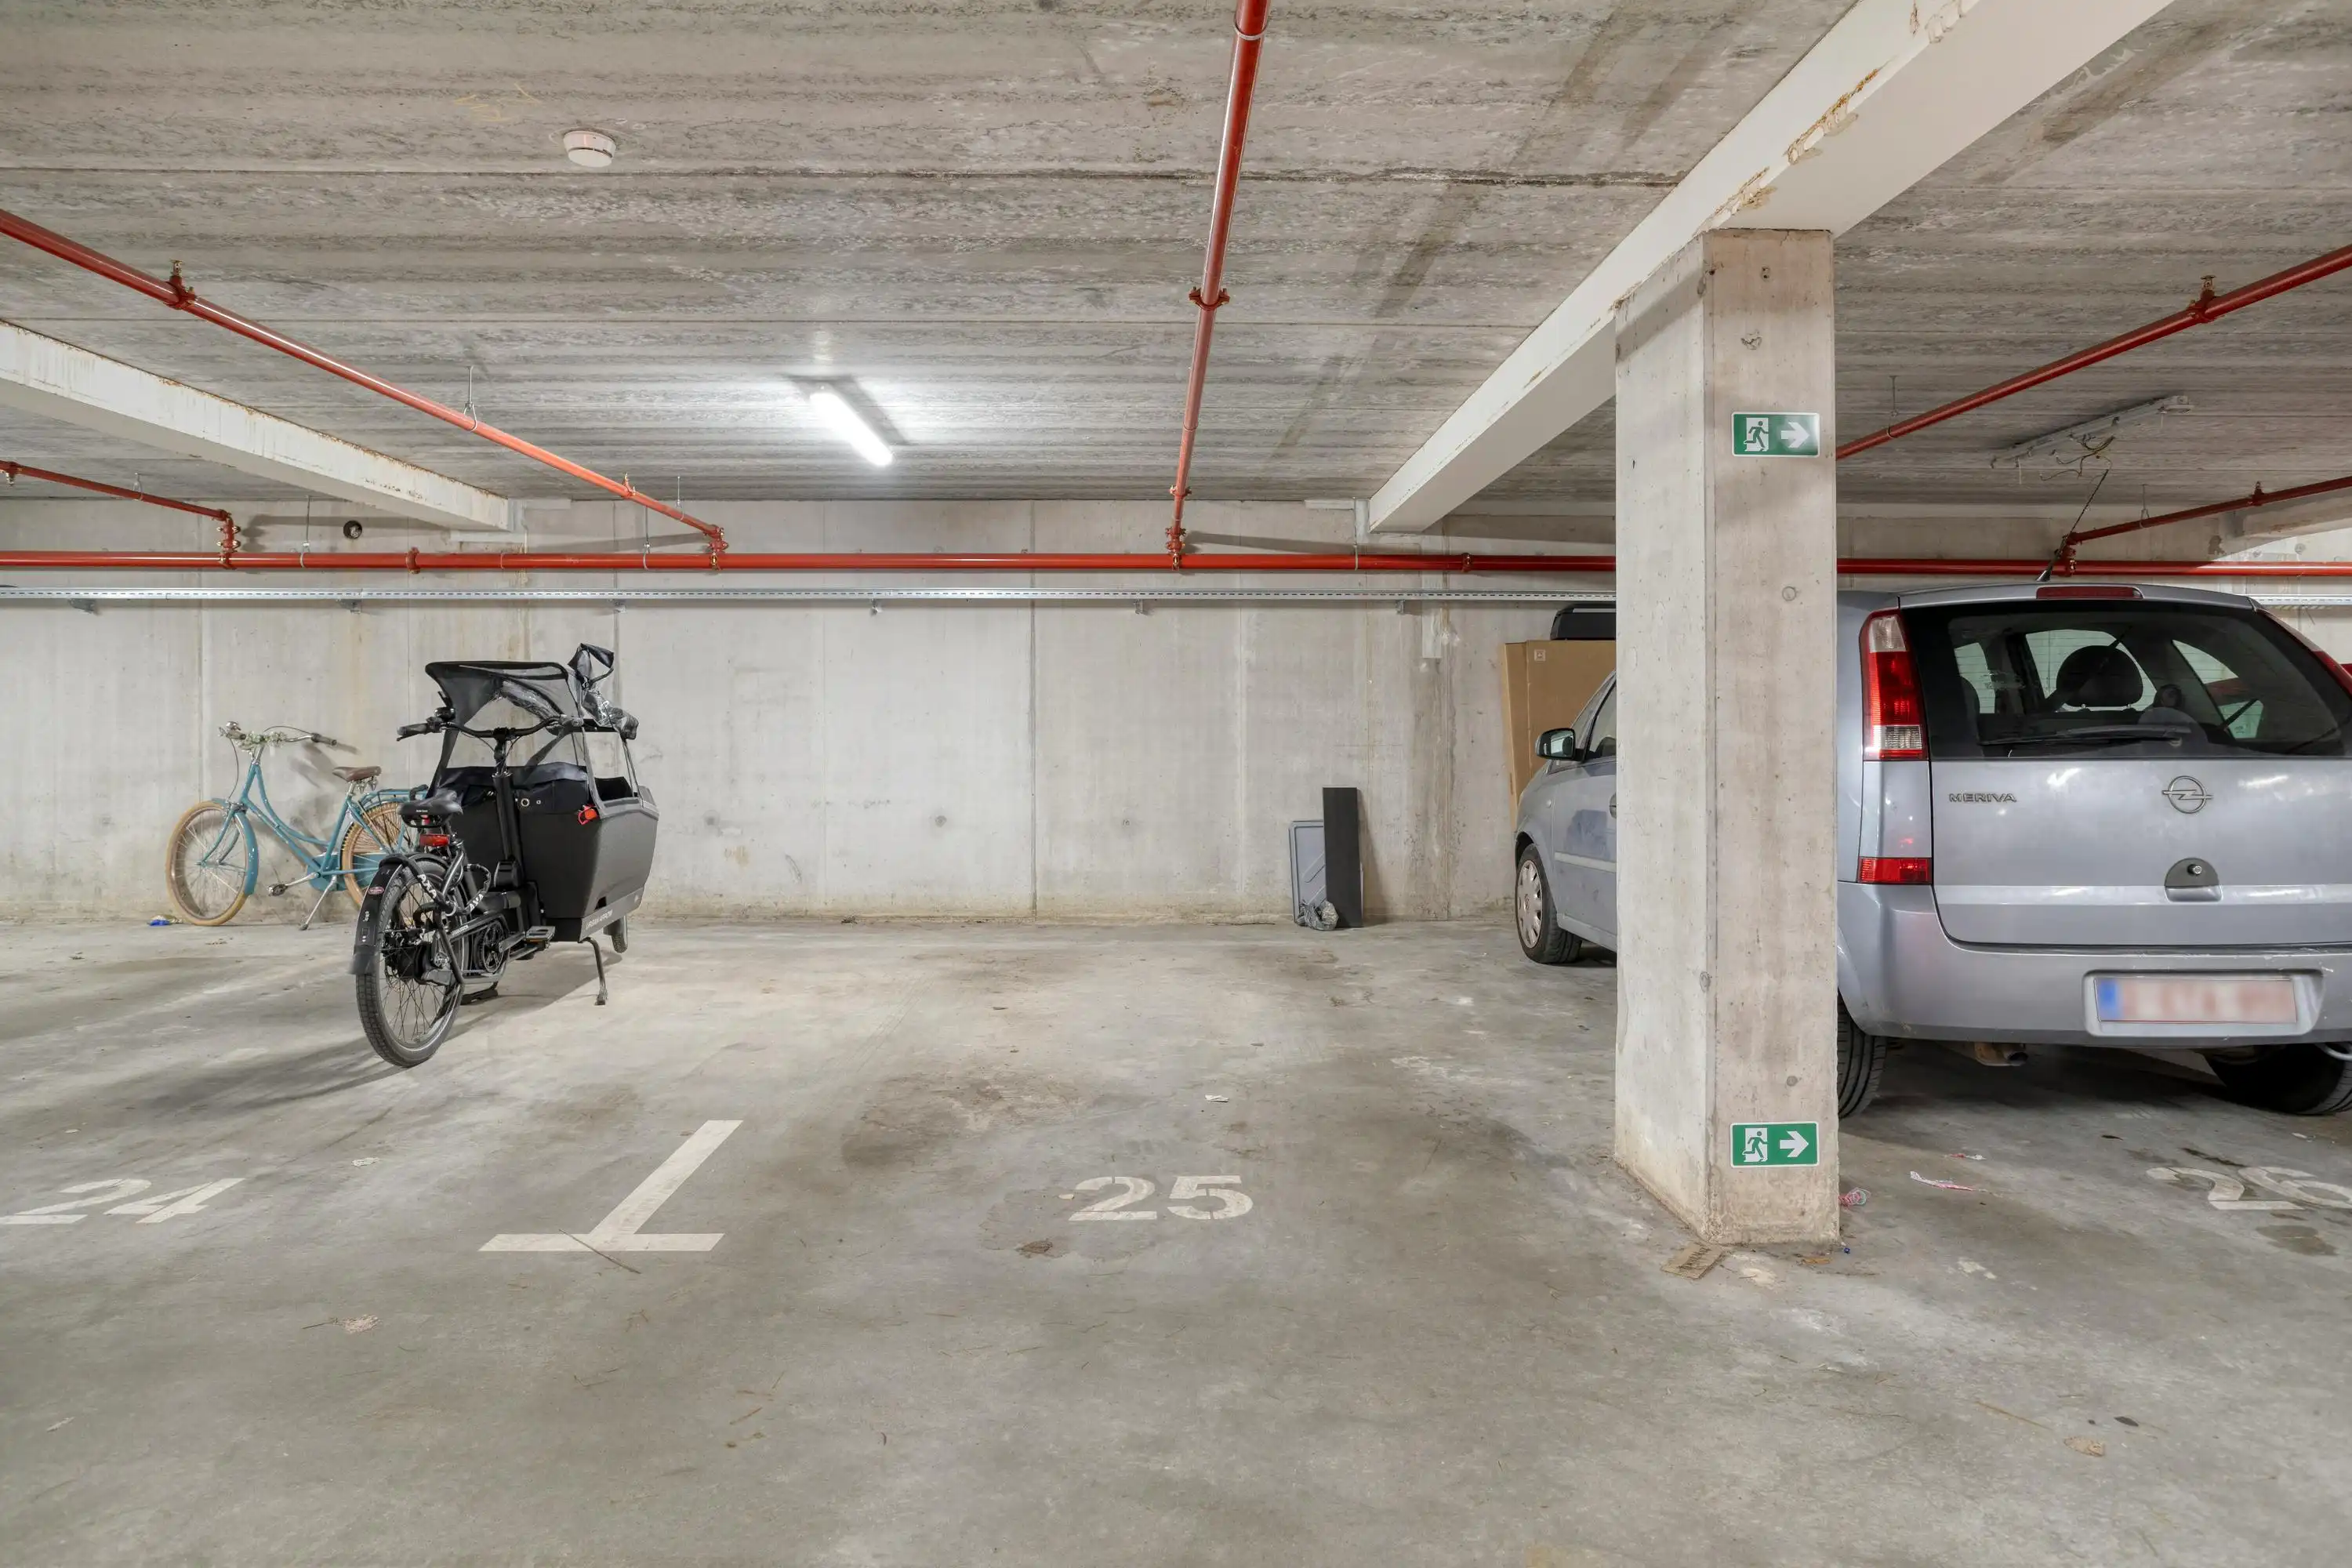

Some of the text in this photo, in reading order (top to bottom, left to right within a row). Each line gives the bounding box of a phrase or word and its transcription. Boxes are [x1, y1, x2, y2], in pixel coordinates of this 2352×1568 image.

[1949, 793, 2017, 803] MERIVA
[416, 873, 437, 898] AXA
[0, 1178, 246, 1224] 24
[1069, 1176, 1254, 1221] 25
[2146, 1167, 2352, 1210] 26
